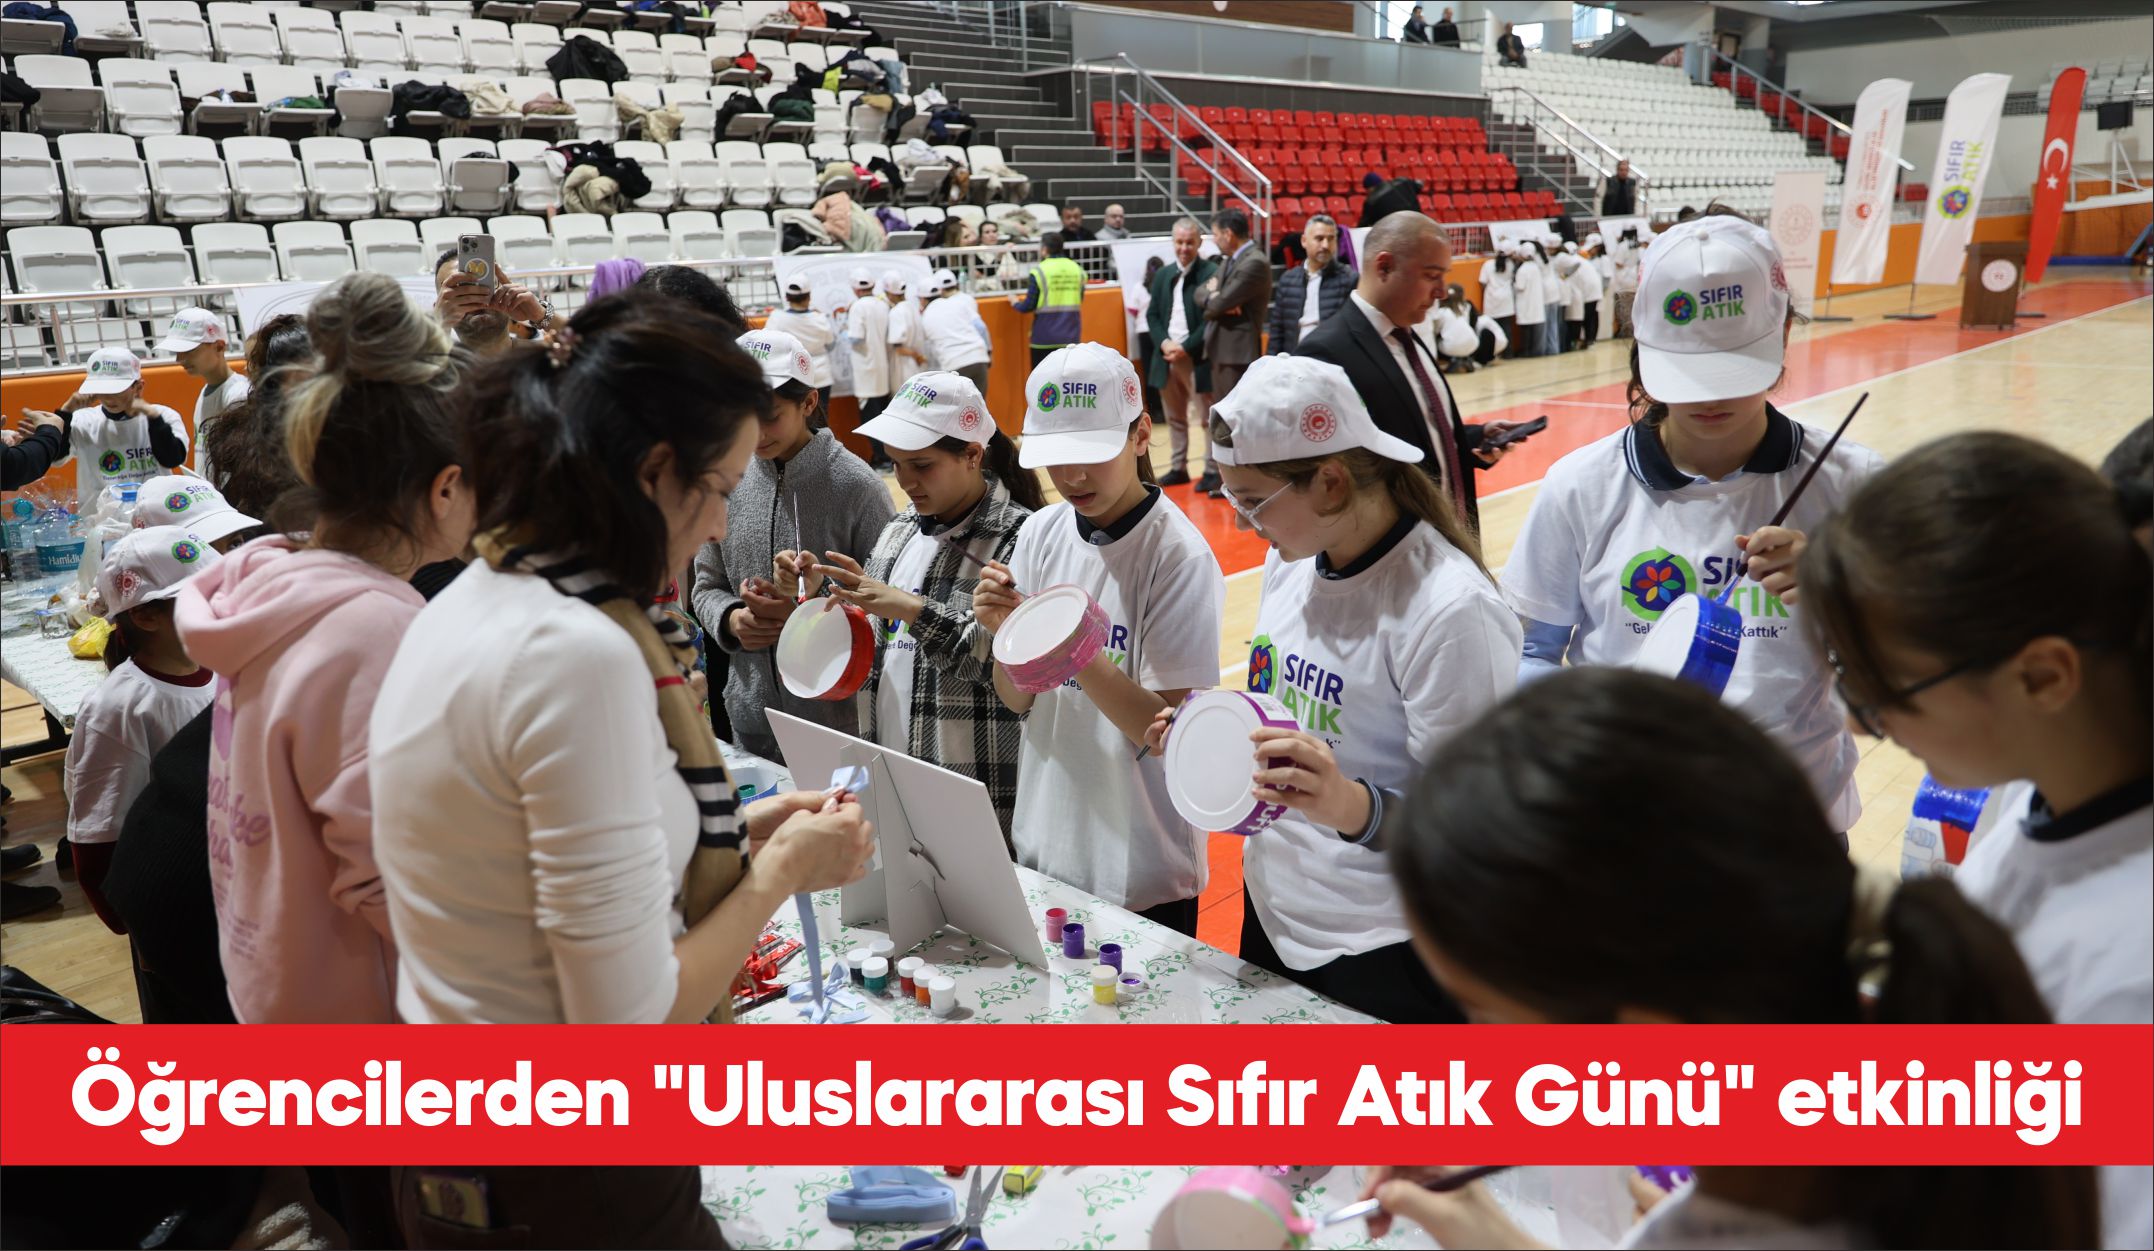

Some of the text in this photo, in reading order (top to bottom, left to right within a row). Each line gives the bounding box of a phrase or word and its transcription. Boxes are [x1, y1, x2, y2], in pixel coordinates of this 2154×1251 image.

[1943, 140, 1965, 182] SIFIR
[1960, 140, 1984, 182] ATIK
[1700, 284, 1743, 305] SIFIR
[1702, 300, 1745, 320] ATIK
[744, 341, 772, 352] SIFIR
[751, 349, 769, 360] TIK
[102, 360, 118, 368] SIFIR
[911, 382, 937, 400] SIFIR
[1062, 382, 1097, 395] SIFIR
[906, 390, 932, 408] ATIK
[1062, 394, 1097, 408] ATIK
[1706, 586, 1790, 618] TIK
[1284, 653, 1344, 706] SIFIR
[1281, 685, 1343, 736] ATIK
